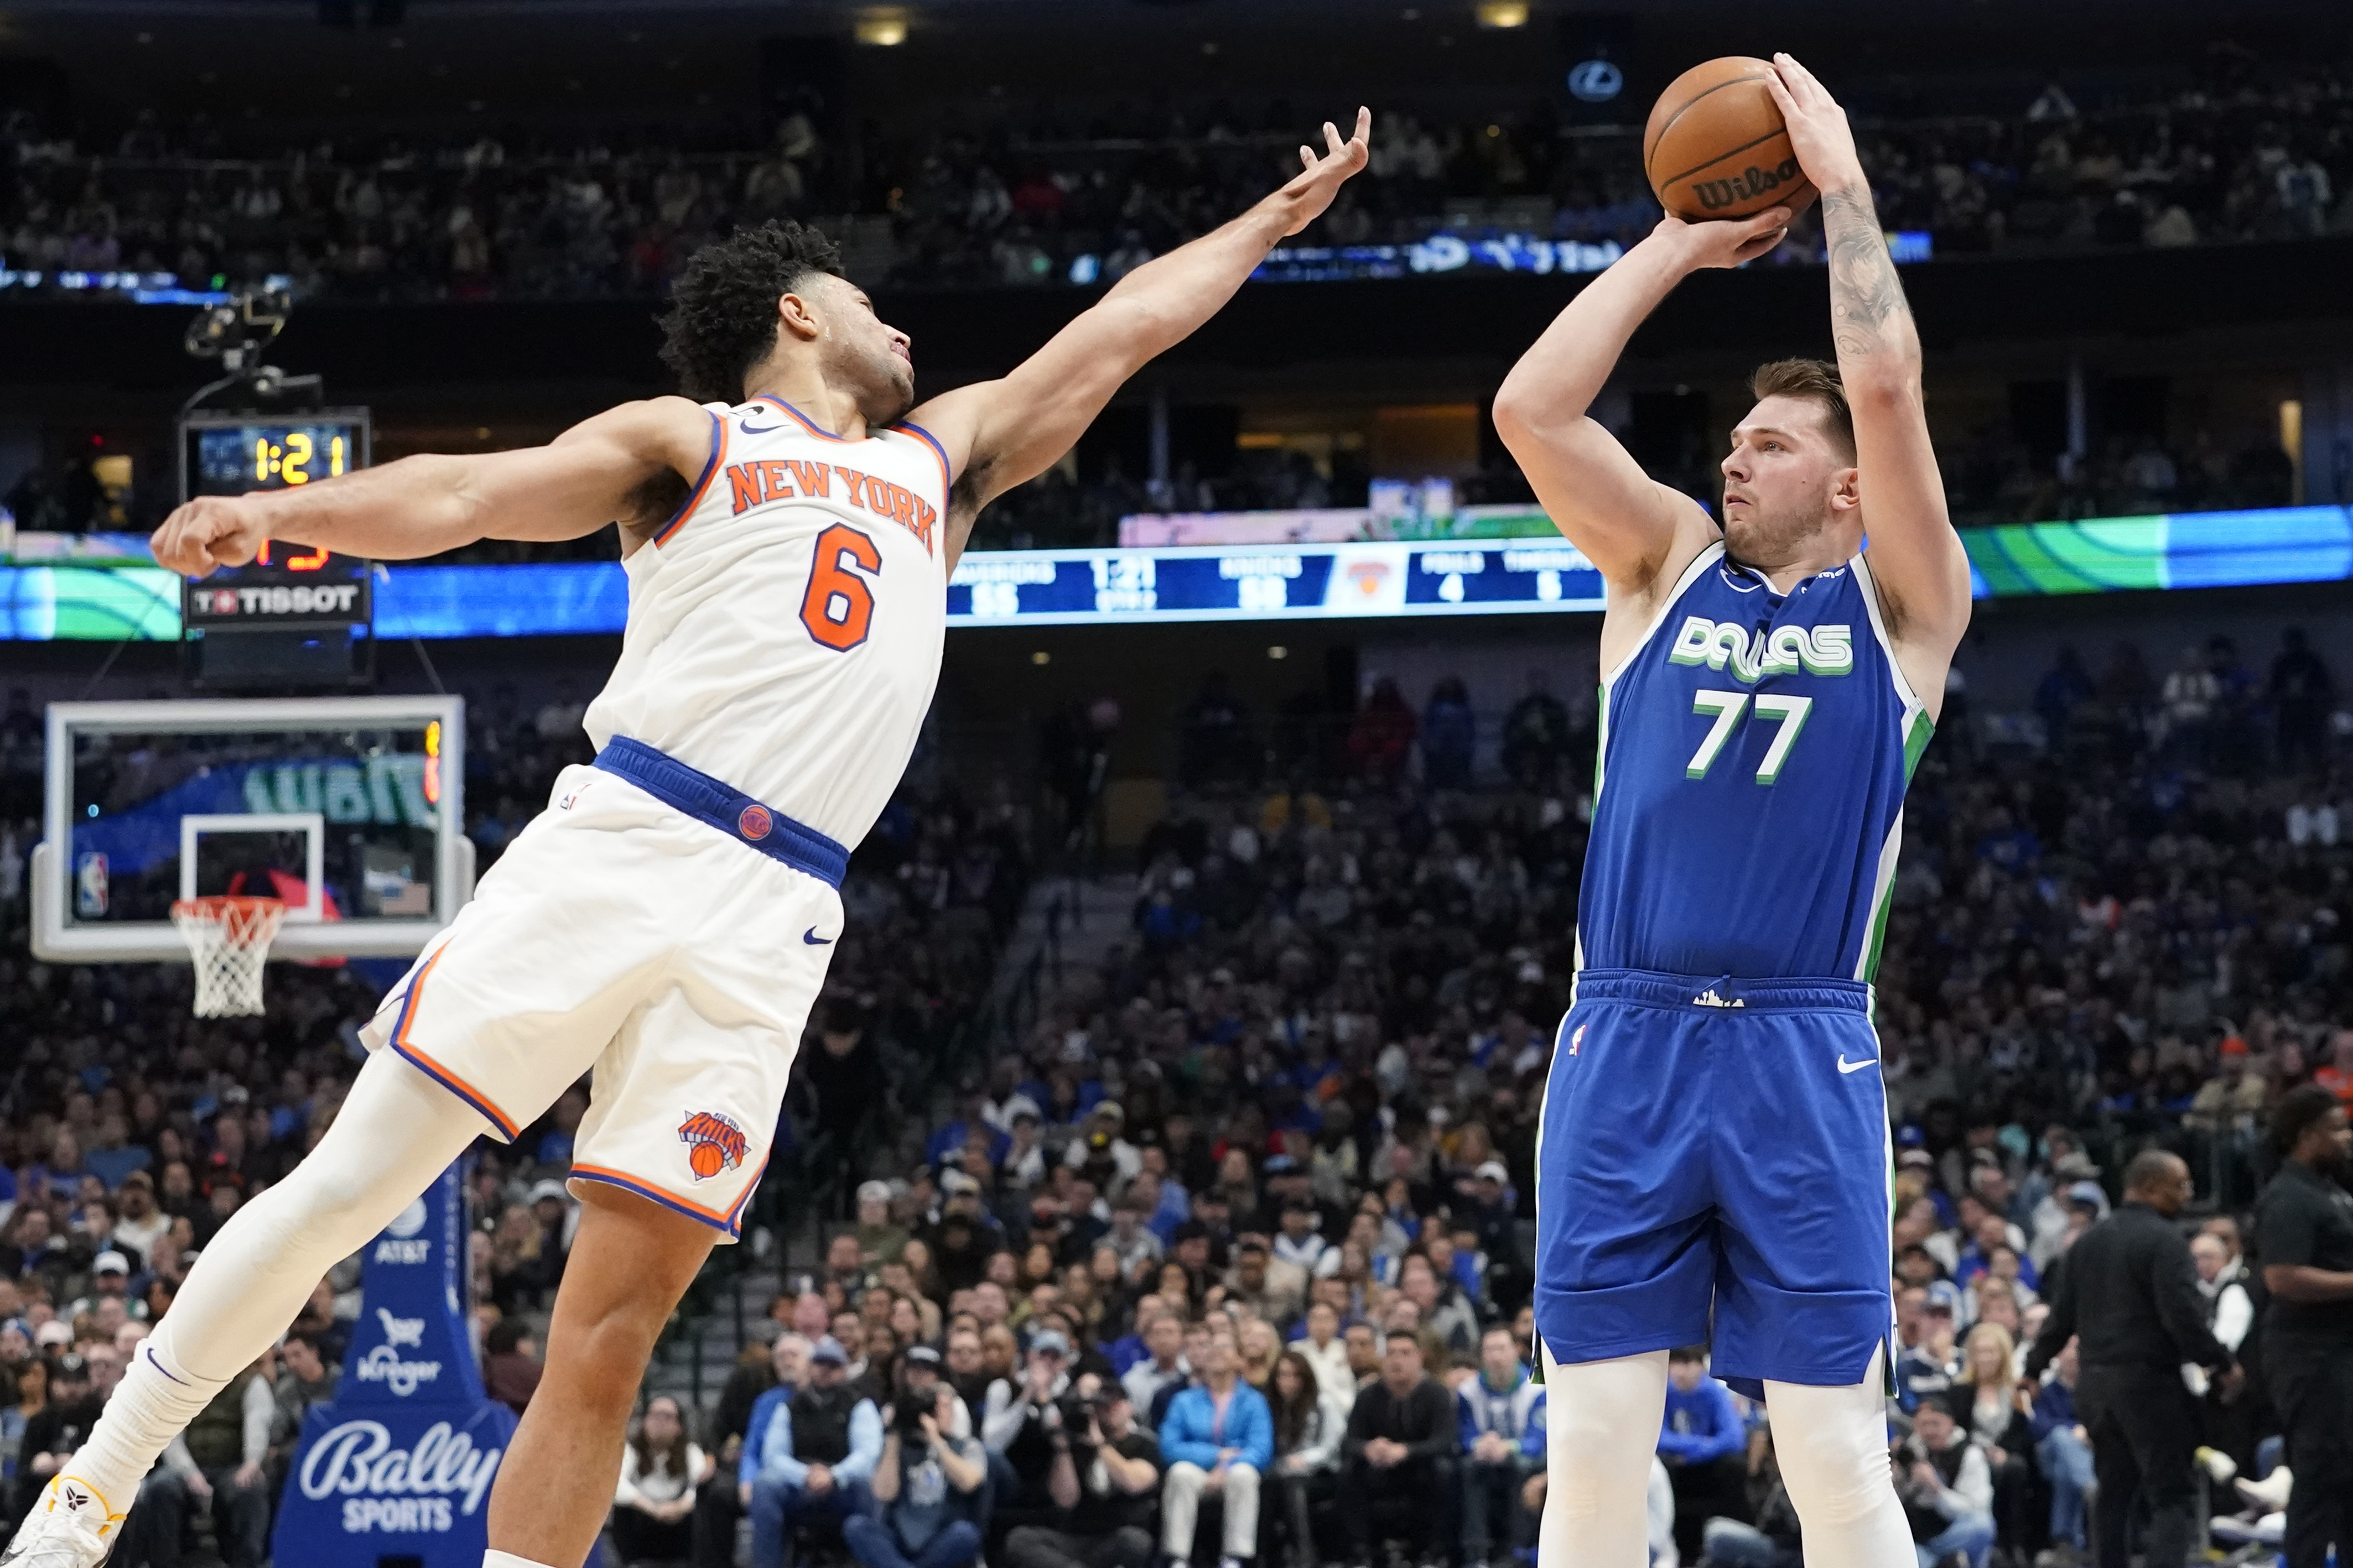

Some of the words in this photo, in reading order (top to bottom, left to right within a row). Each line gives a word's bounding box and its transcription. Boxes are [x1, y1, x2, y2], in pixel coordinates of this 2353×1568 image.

[1692, 157, 1801, 210] Wilso
[256, 433, 344, 485] 1:21
[726, 460, 829, 516] NEW
[834, 466, 937, 562] YORK
[799, 522, 882, 653] 6
[1091, 556, 1156, 590] 1:21
[1438, 572, 1464, 602] 4
[239, 585, 359, 614] TISSOT
[1686, 689, 1812, 785] 77
[679, 1112, 746, 1167] KNICKS
[713, 1112, 728, 1122] NEW
[375, 1239, 432, 1264] AT&T
[357, 1345, 442, 1397] Kroger
[300, 1420, 501, 1517] Bally
[342, 1497, 454, 1533] SPORTS
